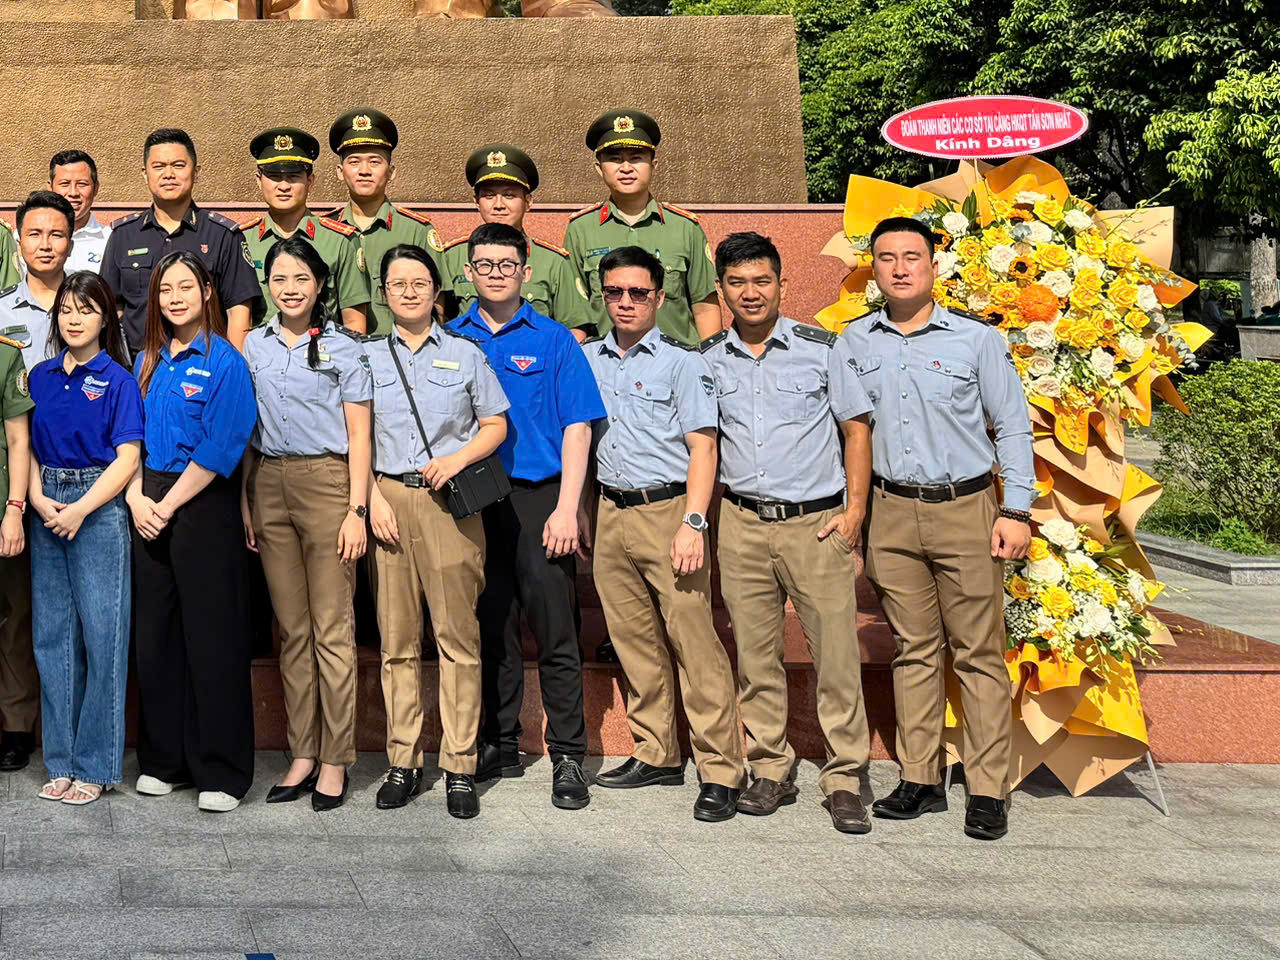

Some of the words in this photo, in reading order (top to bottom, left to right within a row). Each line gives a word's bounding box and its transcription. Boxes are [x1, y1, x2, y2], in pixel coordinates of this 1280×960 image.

[918, 119, 937, 136] THANH
[937, 114, 952, 135] NIÊN
[952, 112, 964, 134] CÁC
[983, 115, 994, 136] TẠI
[994, 111, 1011, 132] CẢNG
[1028, 108, 1040, 130] TÂN
[1041, 112, 1055, 130] SƠN
[1055, 107, 1072, 129] NHẤT
[935, 138, 980, 150] Kính
[987, 135, 1040, 148] Dâng
